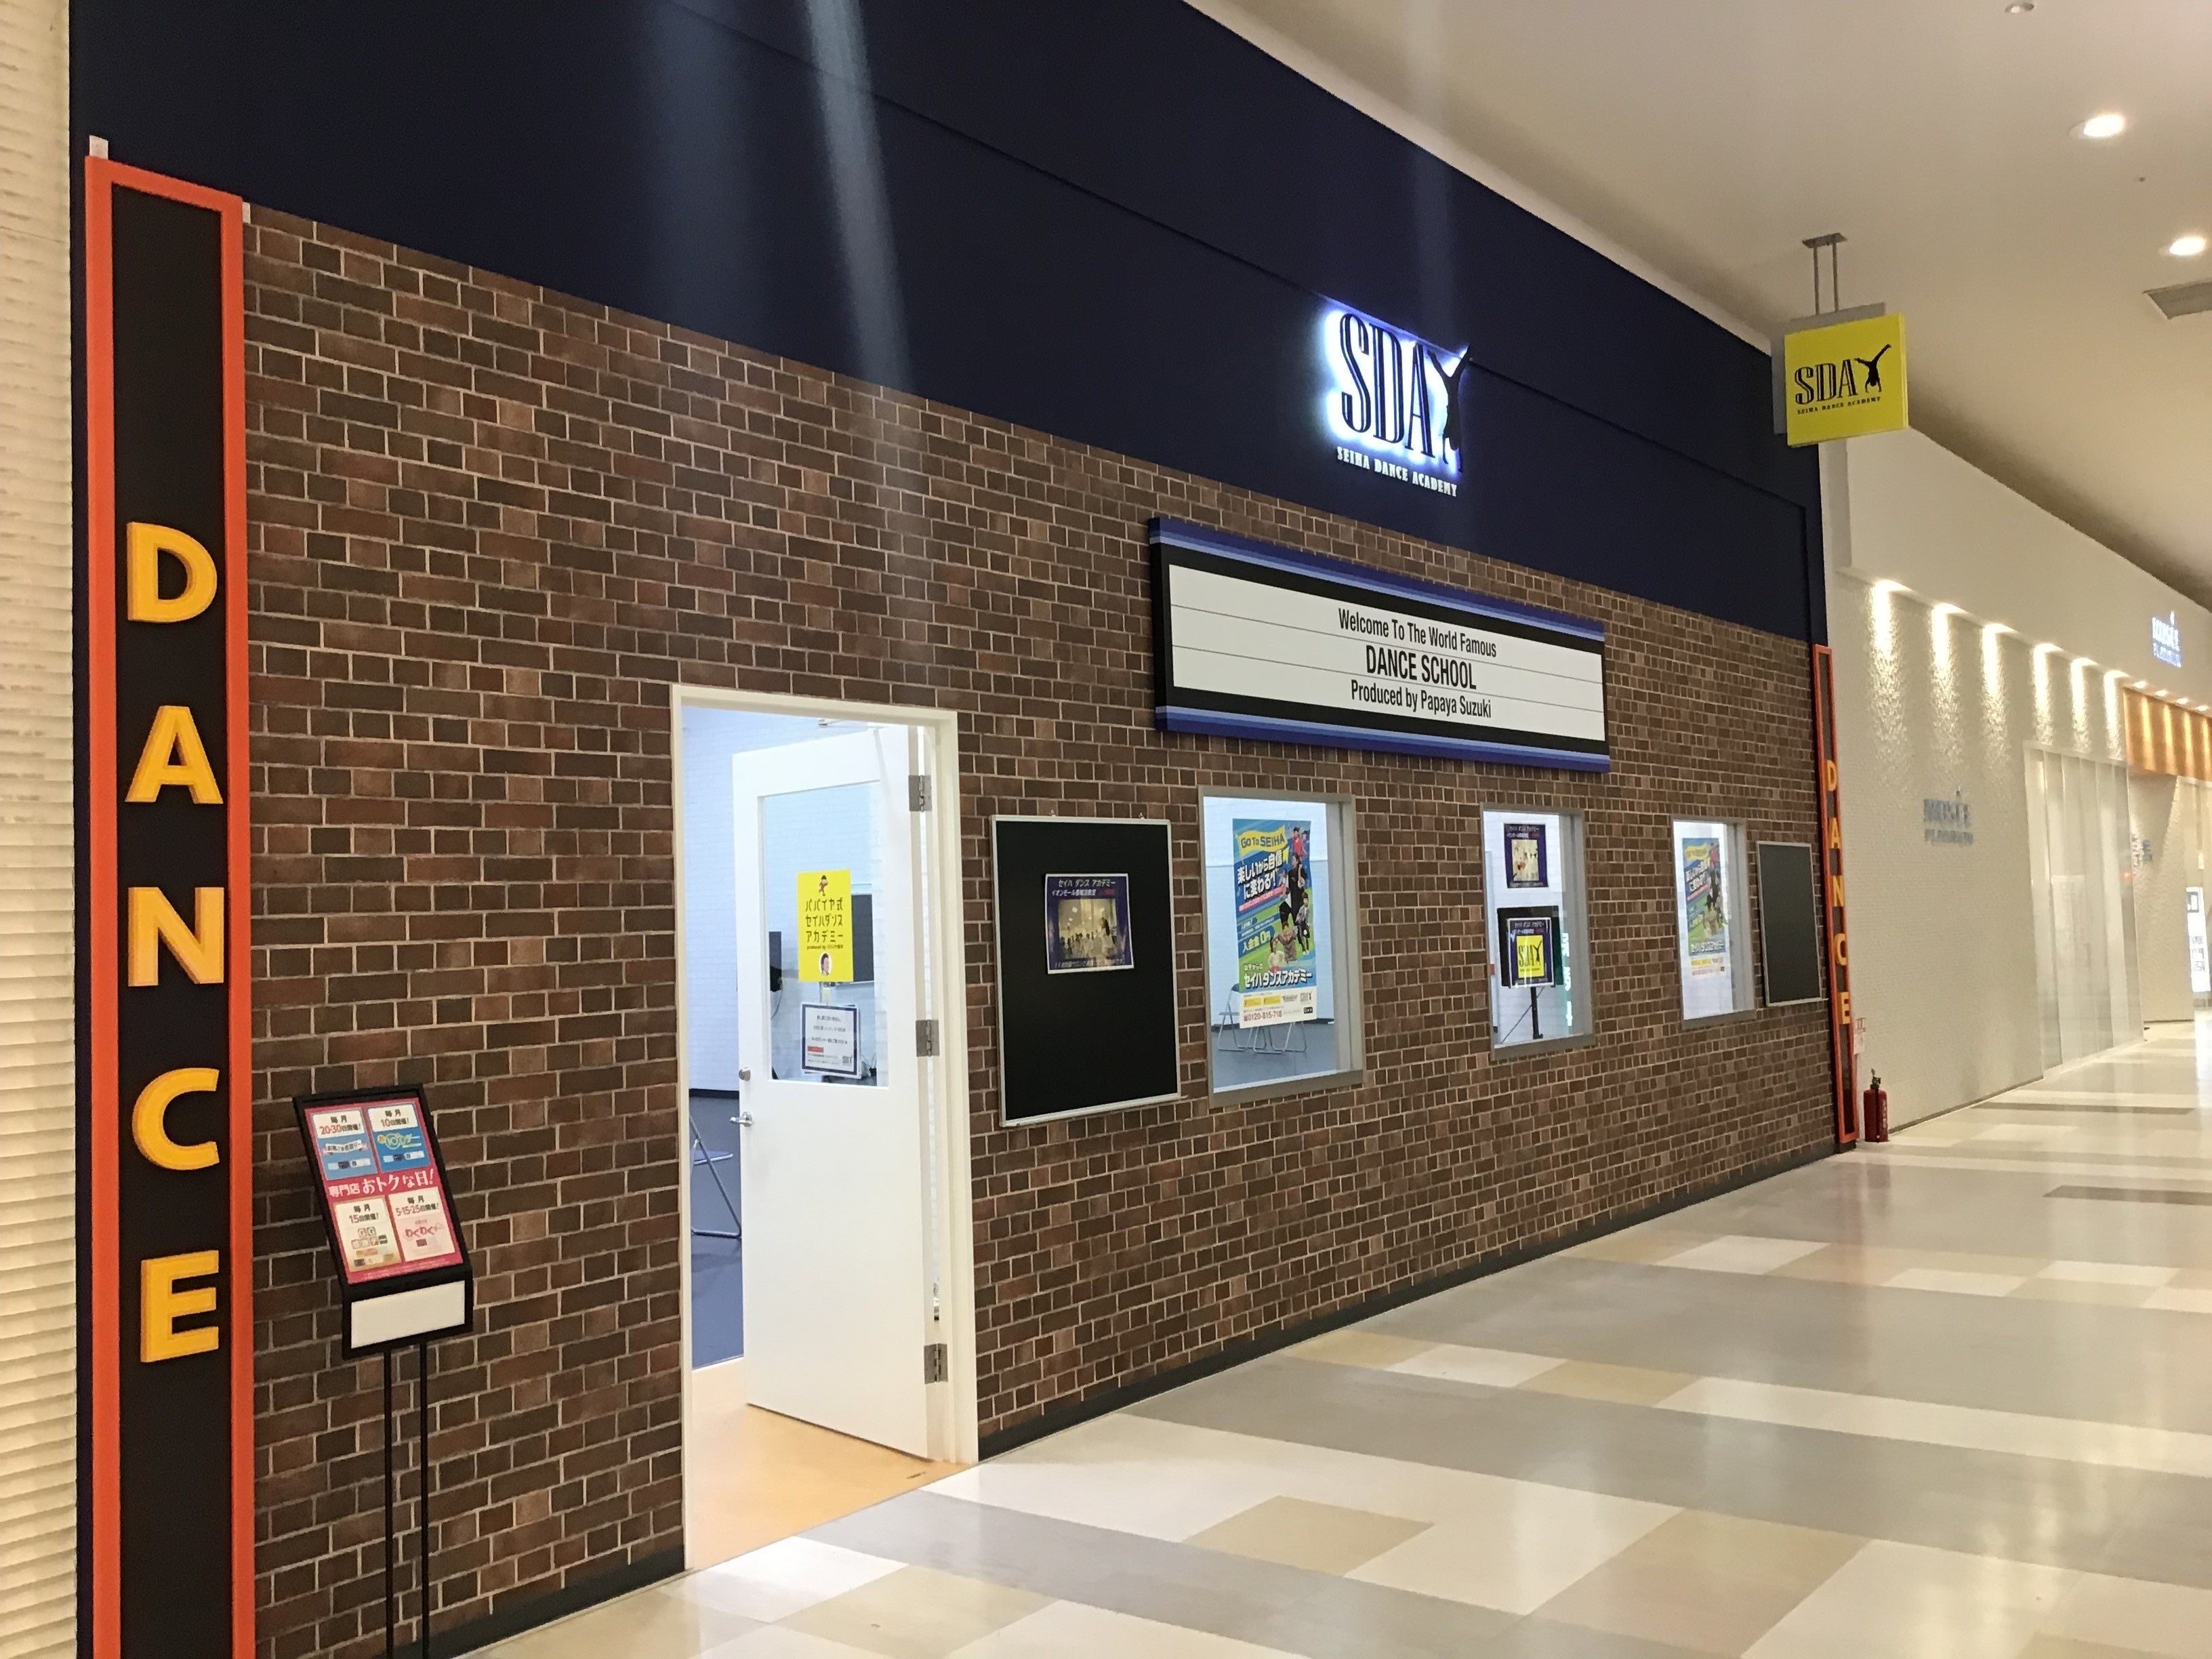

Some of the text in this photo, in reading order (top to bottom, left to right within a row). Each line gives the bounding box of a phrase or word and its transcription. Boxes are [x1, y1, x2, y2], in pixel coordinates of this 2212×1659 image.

[1336, 446, 1458, 497] SEIHA DANCE ACADEMY
[1338, 608, 1497, 657] Welcome To The World Famous
[1366, 644, 1477, 689] DANCE SCHOOL
[1351, 679, 1492, 718] Produced by Papaya Suzuki
[1261, 834, 1285, 847] SEIHA
[1826, 759, 1852, 1025] DANCE
[805, 914, 843, 927] セイハダンス
[806, 929, 844, 943] アカデミー
[125, 521, 224, 1364] DANCE
[1244, 968, 1313, 988] セイハダンスアカデミー
